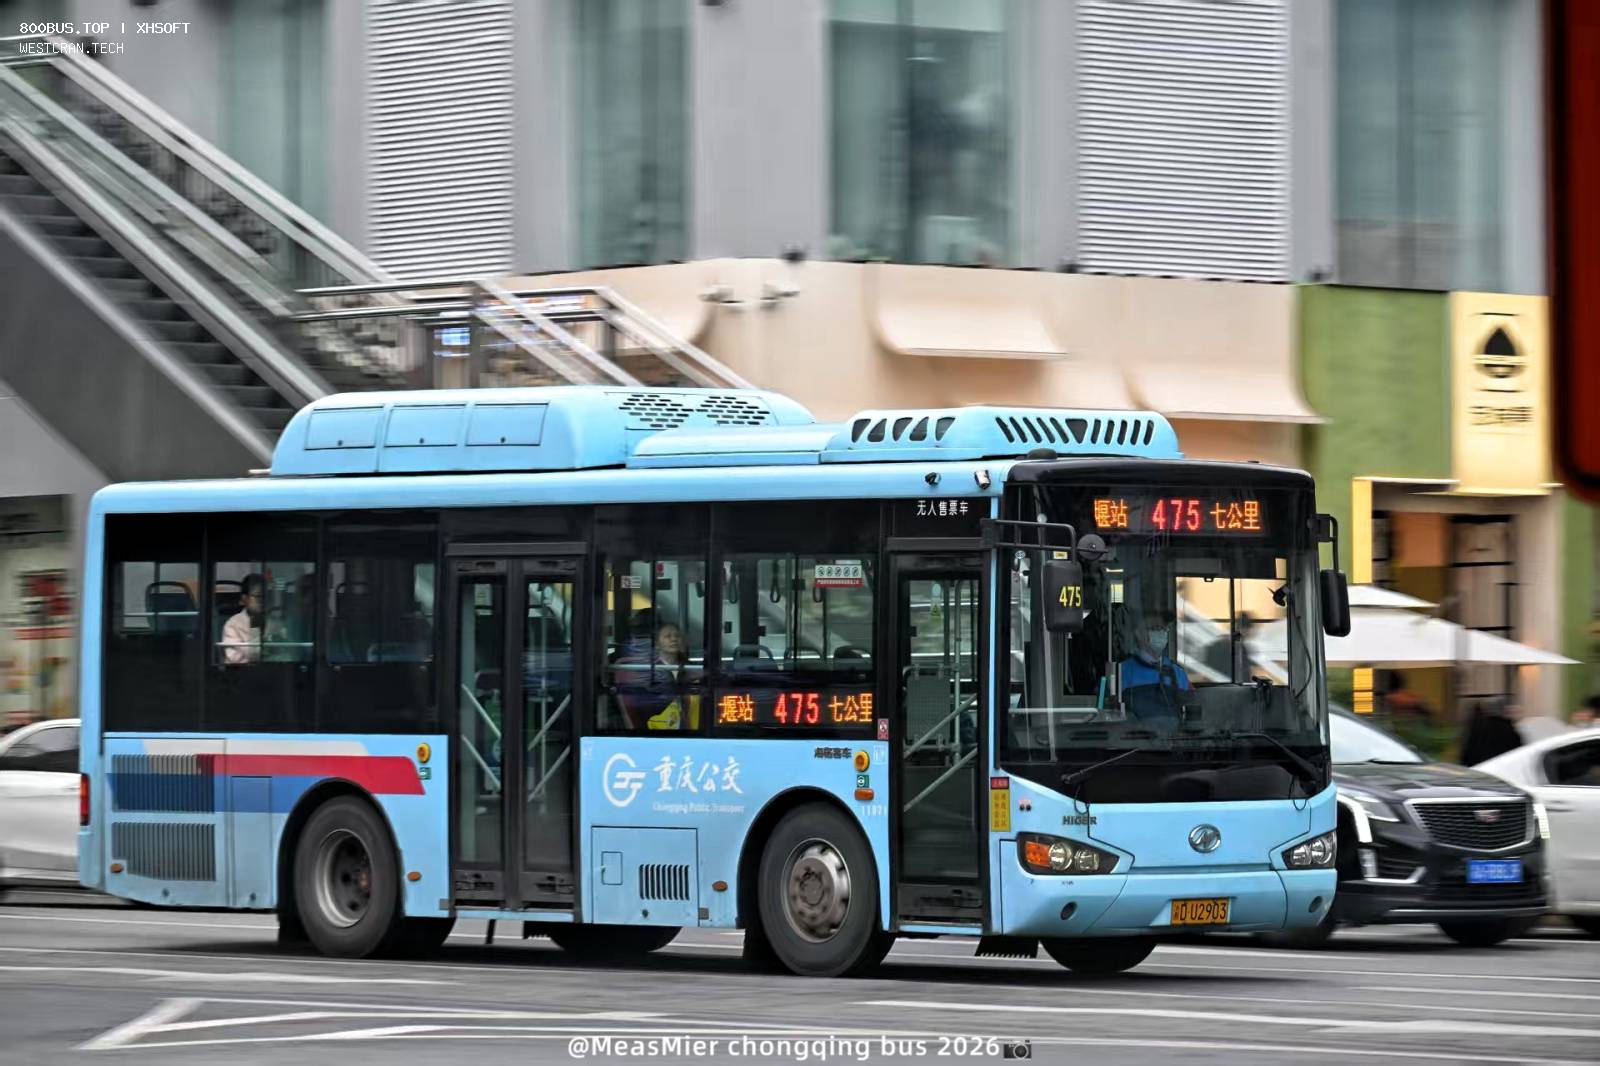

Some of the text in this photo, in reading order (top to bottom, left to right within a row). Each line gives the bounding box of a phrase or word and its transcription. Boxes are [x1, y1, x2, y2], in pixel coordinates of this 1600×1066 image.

[916, 499, 969, 516] 无人售票车
[1152, 499, 1200, 530] 475
[1209, 500, 1261, 530] 七公里
[1059, 586, 1082, 607] 475
[774, 693, 819, 723] 475
[828, 693, 873, 722] 七公里
[653, 755, 744, 794] 重庆公交
[1062, 815, 1098, 826] HIGER
